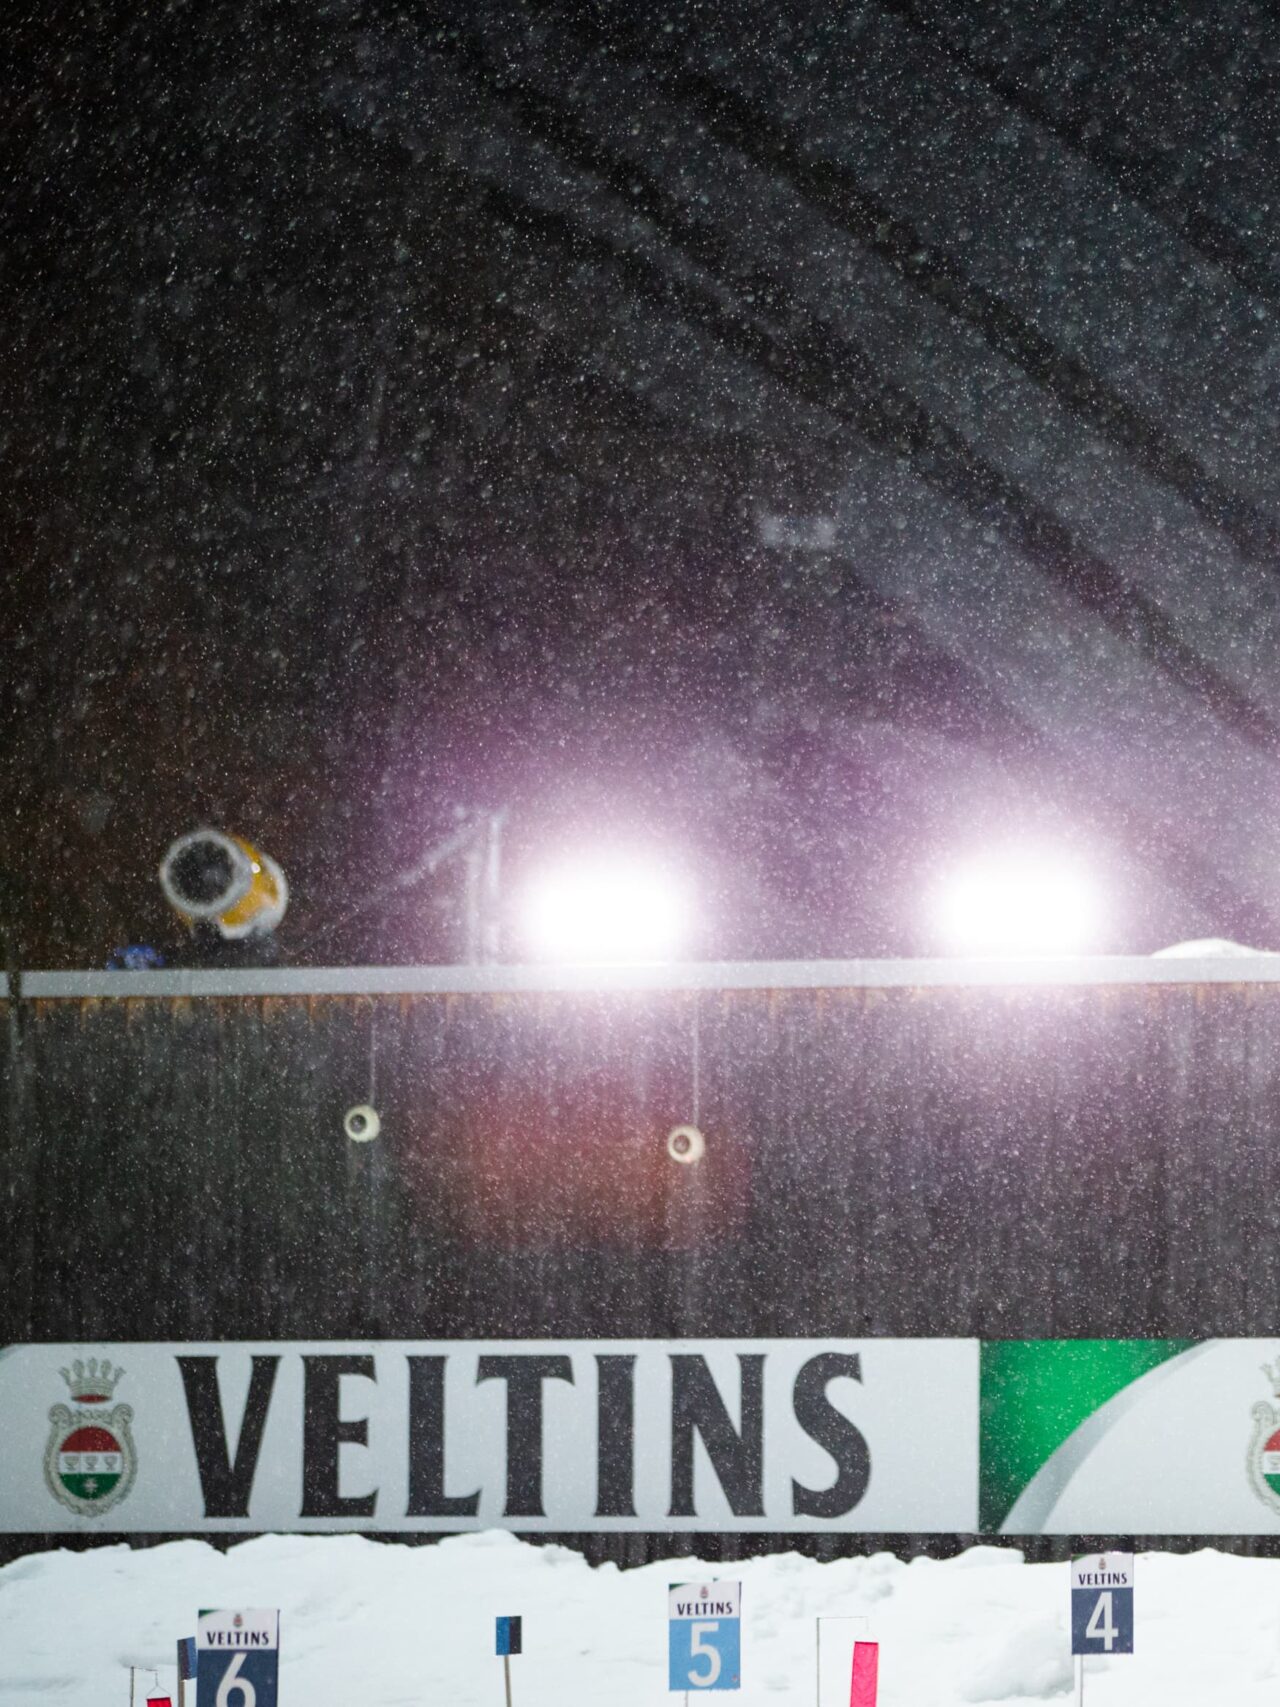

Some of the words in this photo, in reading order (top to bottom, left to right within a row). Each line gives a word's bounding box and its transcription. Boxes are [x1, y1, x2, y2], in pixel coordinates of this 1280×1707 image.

[175, 1352, 871, 1519] VELTINS
[1078, 1572, 1128, 1585] VELTINS
[677, 1601, 733, 1616] VELTINS
[1086, 1591, 1119, 1651] 4
[206, 1631, 269, 1645] VELTINS
[687, 1621, 721, 1687] 5
[216, 1652, 257, 1707] 6
